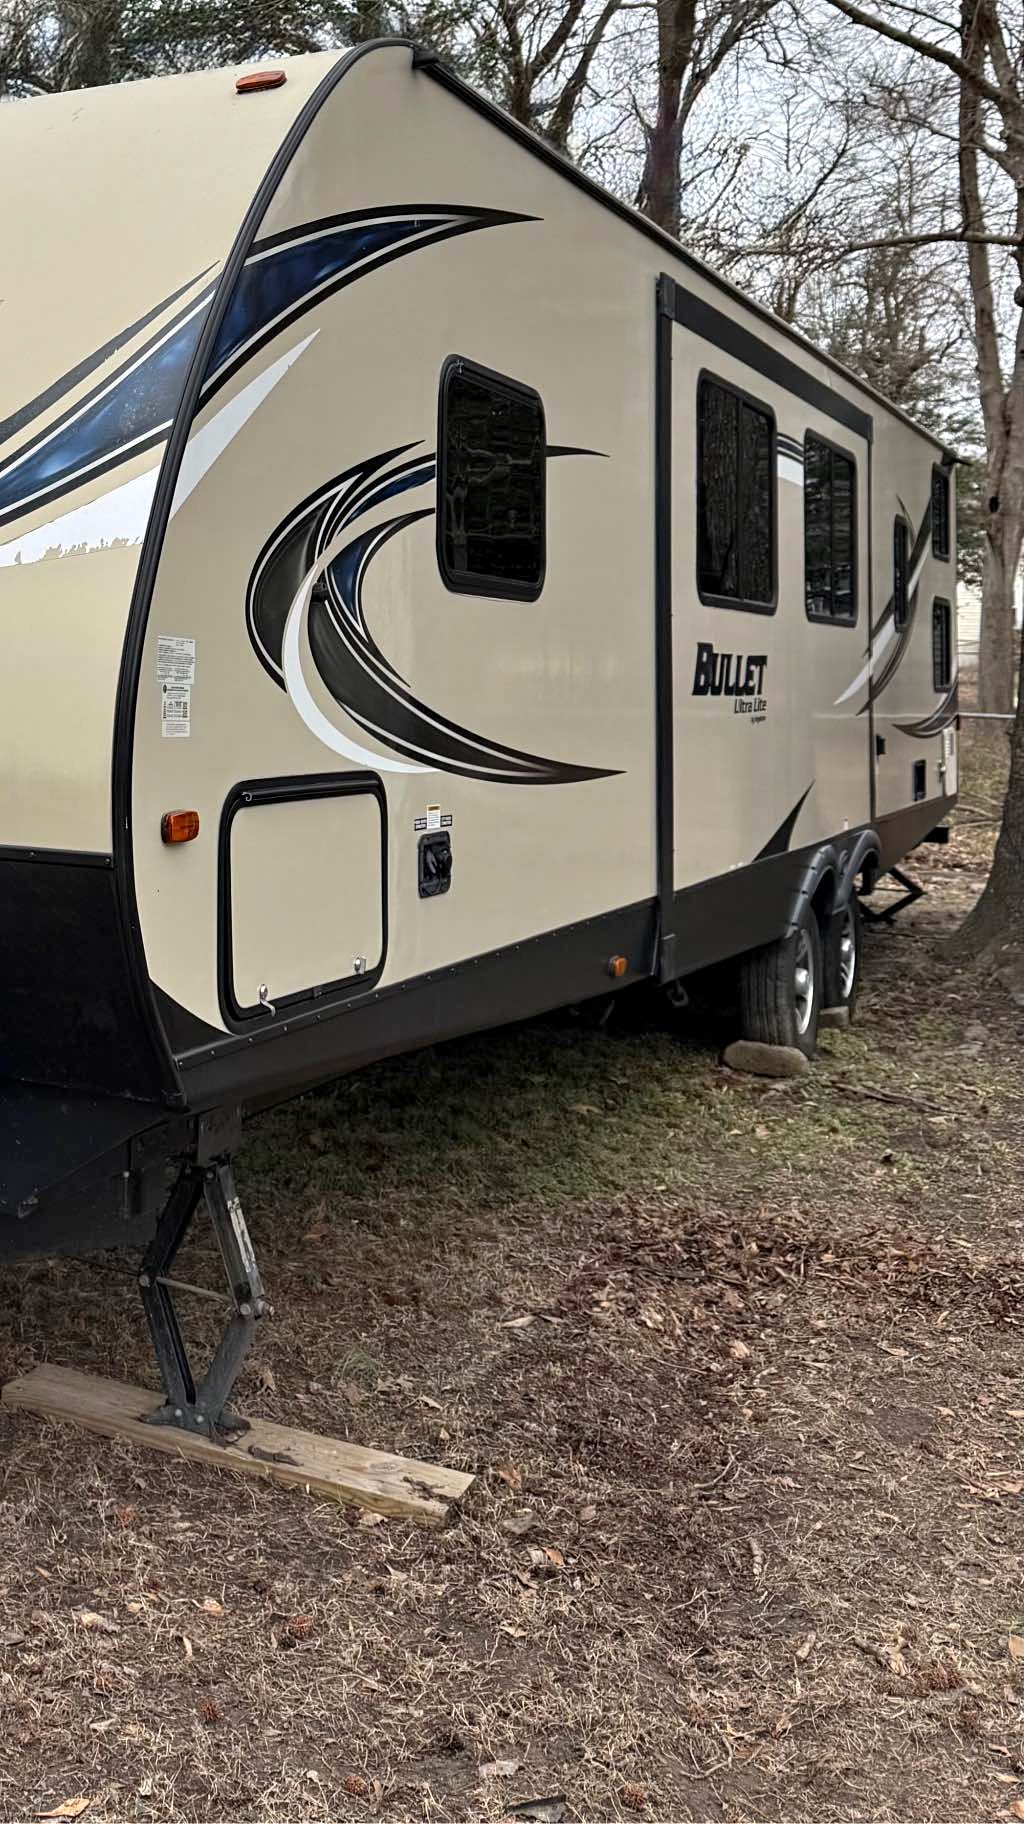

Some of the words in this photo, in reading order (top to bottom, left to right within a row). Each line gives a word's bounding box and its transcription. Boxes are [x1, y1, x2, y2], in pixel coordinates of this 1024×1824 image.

[691, 641, 768, 697] BULLET
[734, 698, 753, 714] Ultra
[754, 697, 767, 712] Lite
